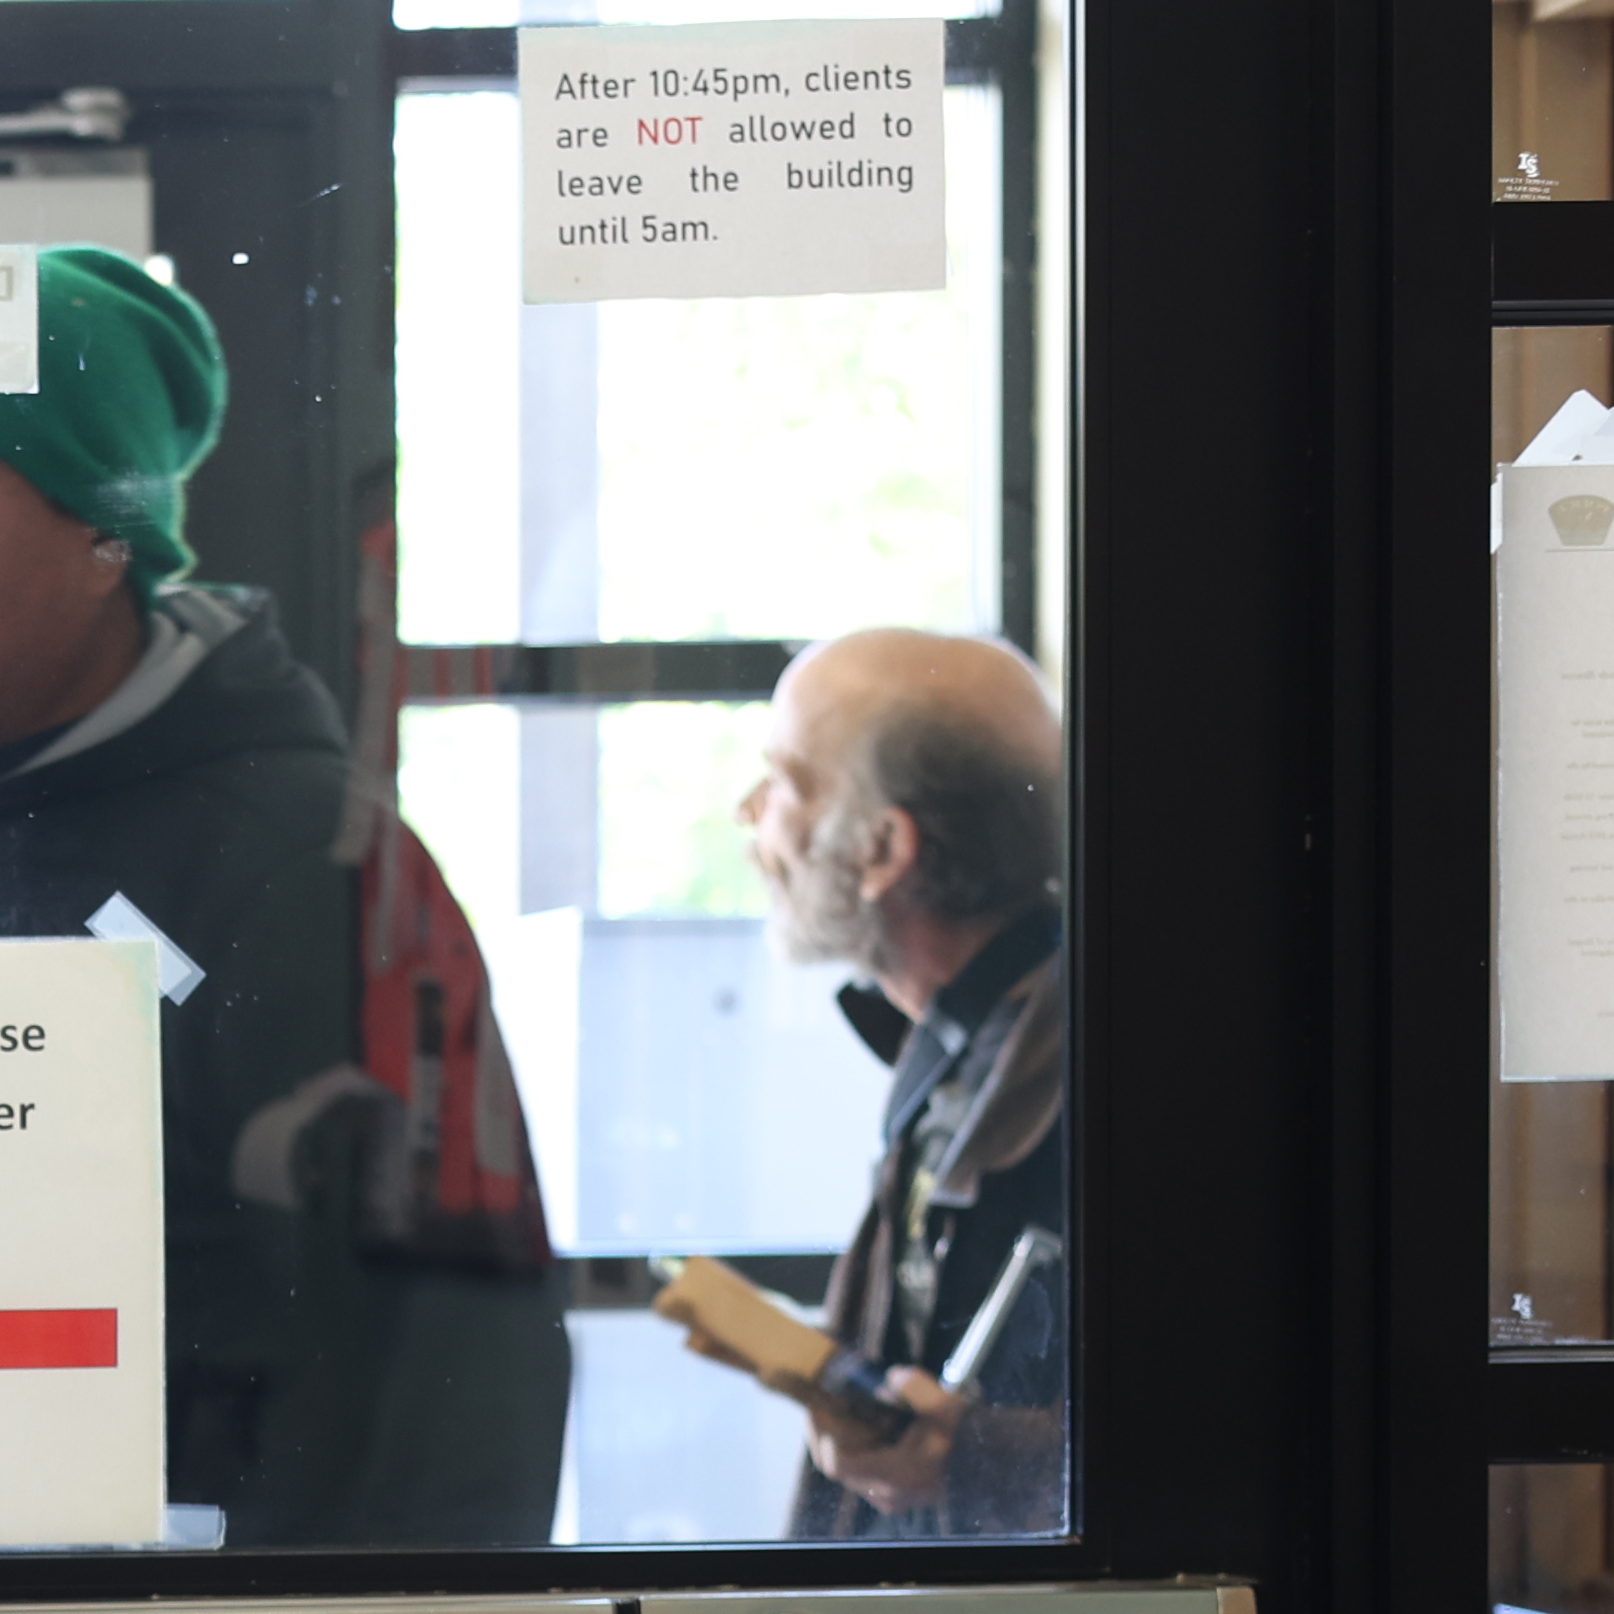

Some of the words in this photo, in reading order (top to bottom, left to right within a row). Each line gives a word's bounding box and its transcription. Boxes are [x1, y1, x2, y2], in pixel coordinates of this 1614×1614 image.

[555, 72, 636, 100] After
[650, 67, 790, 102] 10:45pm,
[804, 64, 912, 93] clients
[556, 127, 608, 149] are
[637, 116, 703, 145] NOT
[729, 111, 855, 144] allowed
[883, 112, 913, 138] to
[557, 170, 643, 198] leave
[689, 165, 739, 193] the
[787, 159, 913, 194] building
[558, 216, 629, 246] until
[642, 214, 719, 243] 5am.
